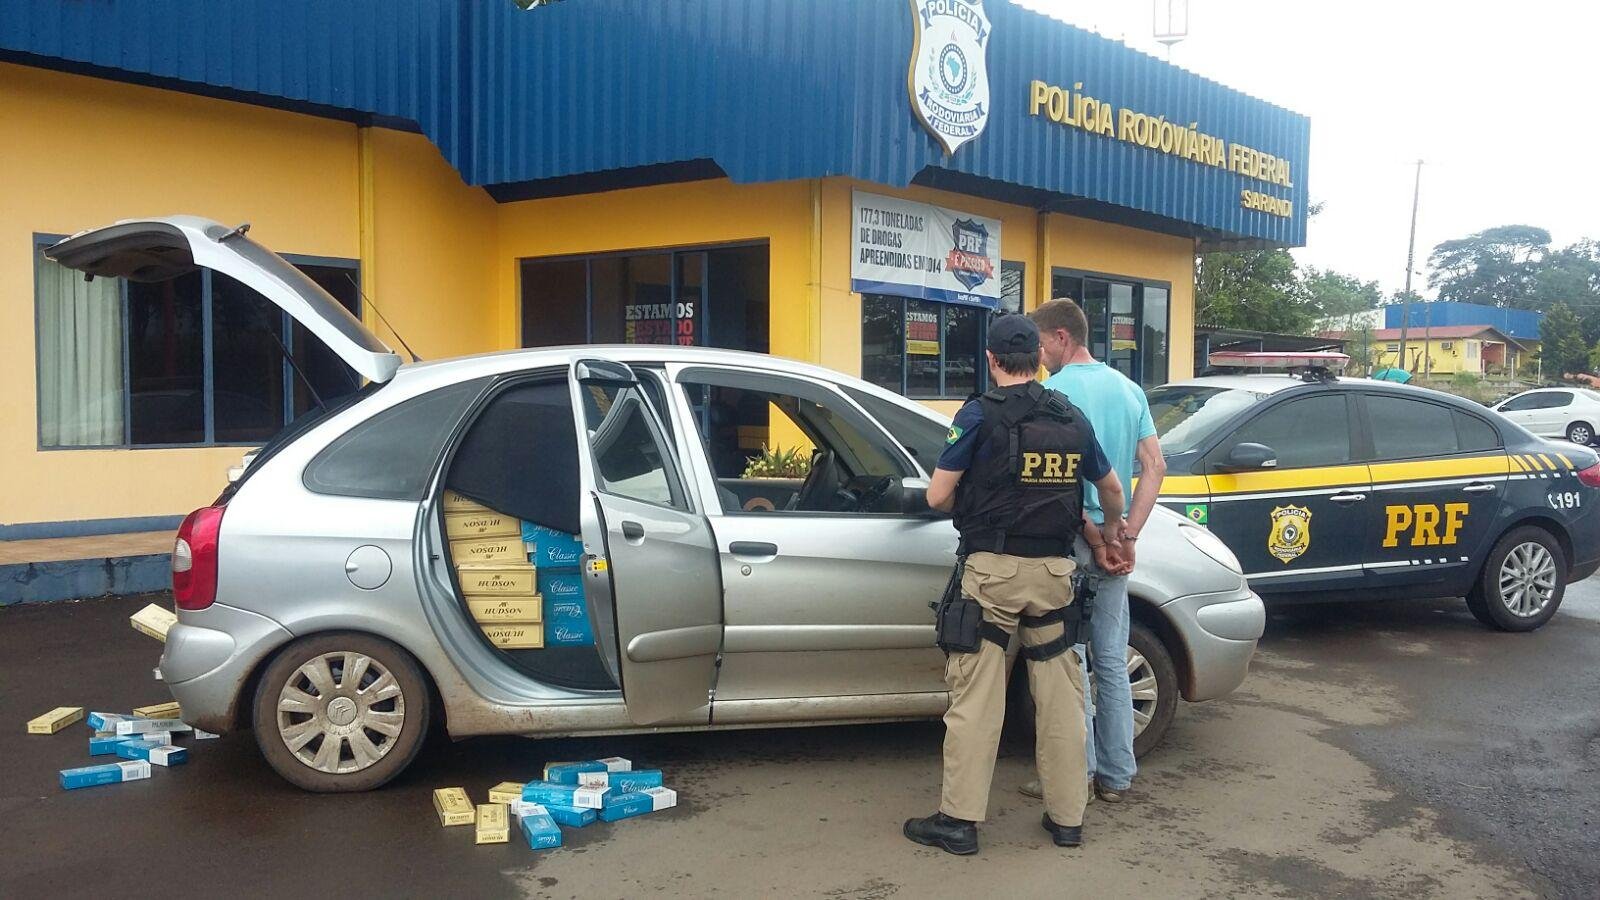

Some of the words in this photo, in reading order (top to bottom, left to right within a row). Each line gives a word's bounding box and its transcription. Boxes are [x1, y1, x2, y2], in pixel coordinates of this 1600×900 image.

[933, 118, 972, 136] FEDERAL
[1030, 80, 1114, 137] POLÍCIA
[1229, 143, 1293, 188] FEDERAL
[1241, 189, 1292, 217] SARANDI
[880, 210, 924, 232] TONELADAS
[860, 227, 871, 244] DE
[872, 228, 903, 249] DROGAS
[959, 233, 983, 254] PRF
[860, 248, 912, 270] APREENDIDAS
[625, 302, 694, 320] ESTAMOS
[1022, 452, 1081, 477] PRF
[1556, 491, 1580, 509] 191
[463, 519, 501, 528] HUDSON
[1382, 502, 1469, 548] PRF
[470, 545, 508, 554] HUDSON
[487, 630, 525, 638] HUDSON
